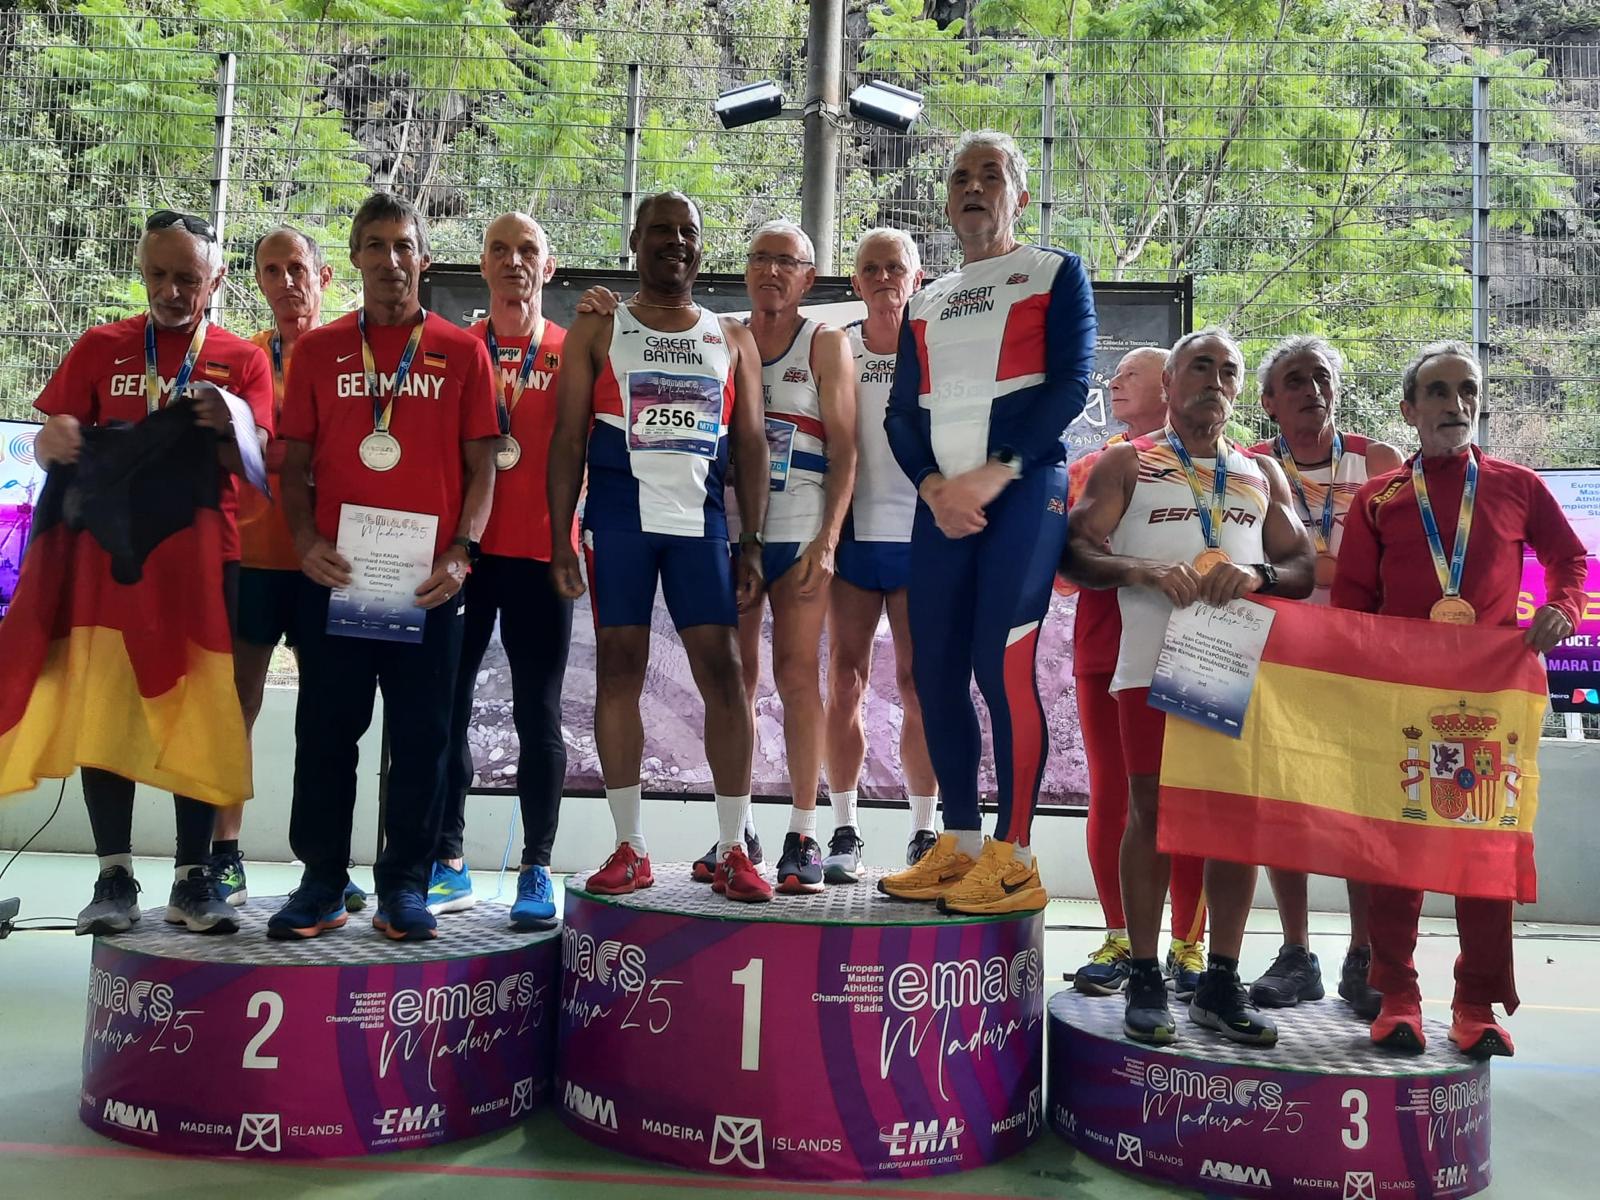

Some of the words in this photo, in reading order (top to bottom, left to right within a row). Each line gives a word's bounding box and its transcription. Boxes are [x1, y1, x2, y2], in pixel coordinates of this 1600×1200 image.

[946, 286, 995, 304] GREAT
[940, 300, 995, 320] BRITAIN
[646, 336, 697, 350] GREAT
[644, 349, 703, 365] BRITAIN
[866, 360, 897, 370] GRE
[336, 372, 445, 400] GERMANY
[860, 372, 896, 383] BRIT
[645, 408, 695, 428] 2556
[699, 421, 713, 432] M70
[1546, 659, 1589, 672] MARA
[840, 964, 885, 975] European
[847, 974, 884, 982] Masters
[843, 984, 884, 993] Athletics
[889, 948, 1038, 1012] emacs
[350, 992, 387, 1000] European
[389, 972, 534, 1026] emacs
[811, 993, 884, 1004] Championships
[351, 1006, 386, 1015] Athletics
[732, 958, 763, 1071] 1
[854, 1003, 884, 1012] Stadia
[325, 1014, 385, 1024] Championships
[241, 990, 285, 1070] 2
[379, 1016, 511, 1092] Madeira
[879, 1000, 1023, 1102] Madeira
[1146, 1063, 1283, 1110] emacs
[471, 1098, 510, 1115] MADEIRA
[379, 1103, 446, 1135] EMA
[992, 1112, 1026, 1135] MADEIRA
[1143, 1090, 1253, 1147] Madeira
[1341, 1089, 1369, 1150] 3
[179, 1121, 233, 1135] MADEIRA
[287, 1124, 343, 1136] ISLANDS
[643, 1118, 704, 1142] MADEIRA
[772, 1137, 842, 1152] ISLANDS
[885, 1117, 963, 1156] EMA
[1084, 1128, 1115, 1146] MADEIRA
[1146, 1150, 1184, 1167] ISLANDS
[879, 1159, 910, 1170] EUROPEAN
[911, 1157, 937, 1167] MASTERS
[1293, 1176, 1340, 1189] MADEIRA
[1379, 1180, 1416, 1191] ISLANDS
[1436, 1163, 1468, 1189] EMA
